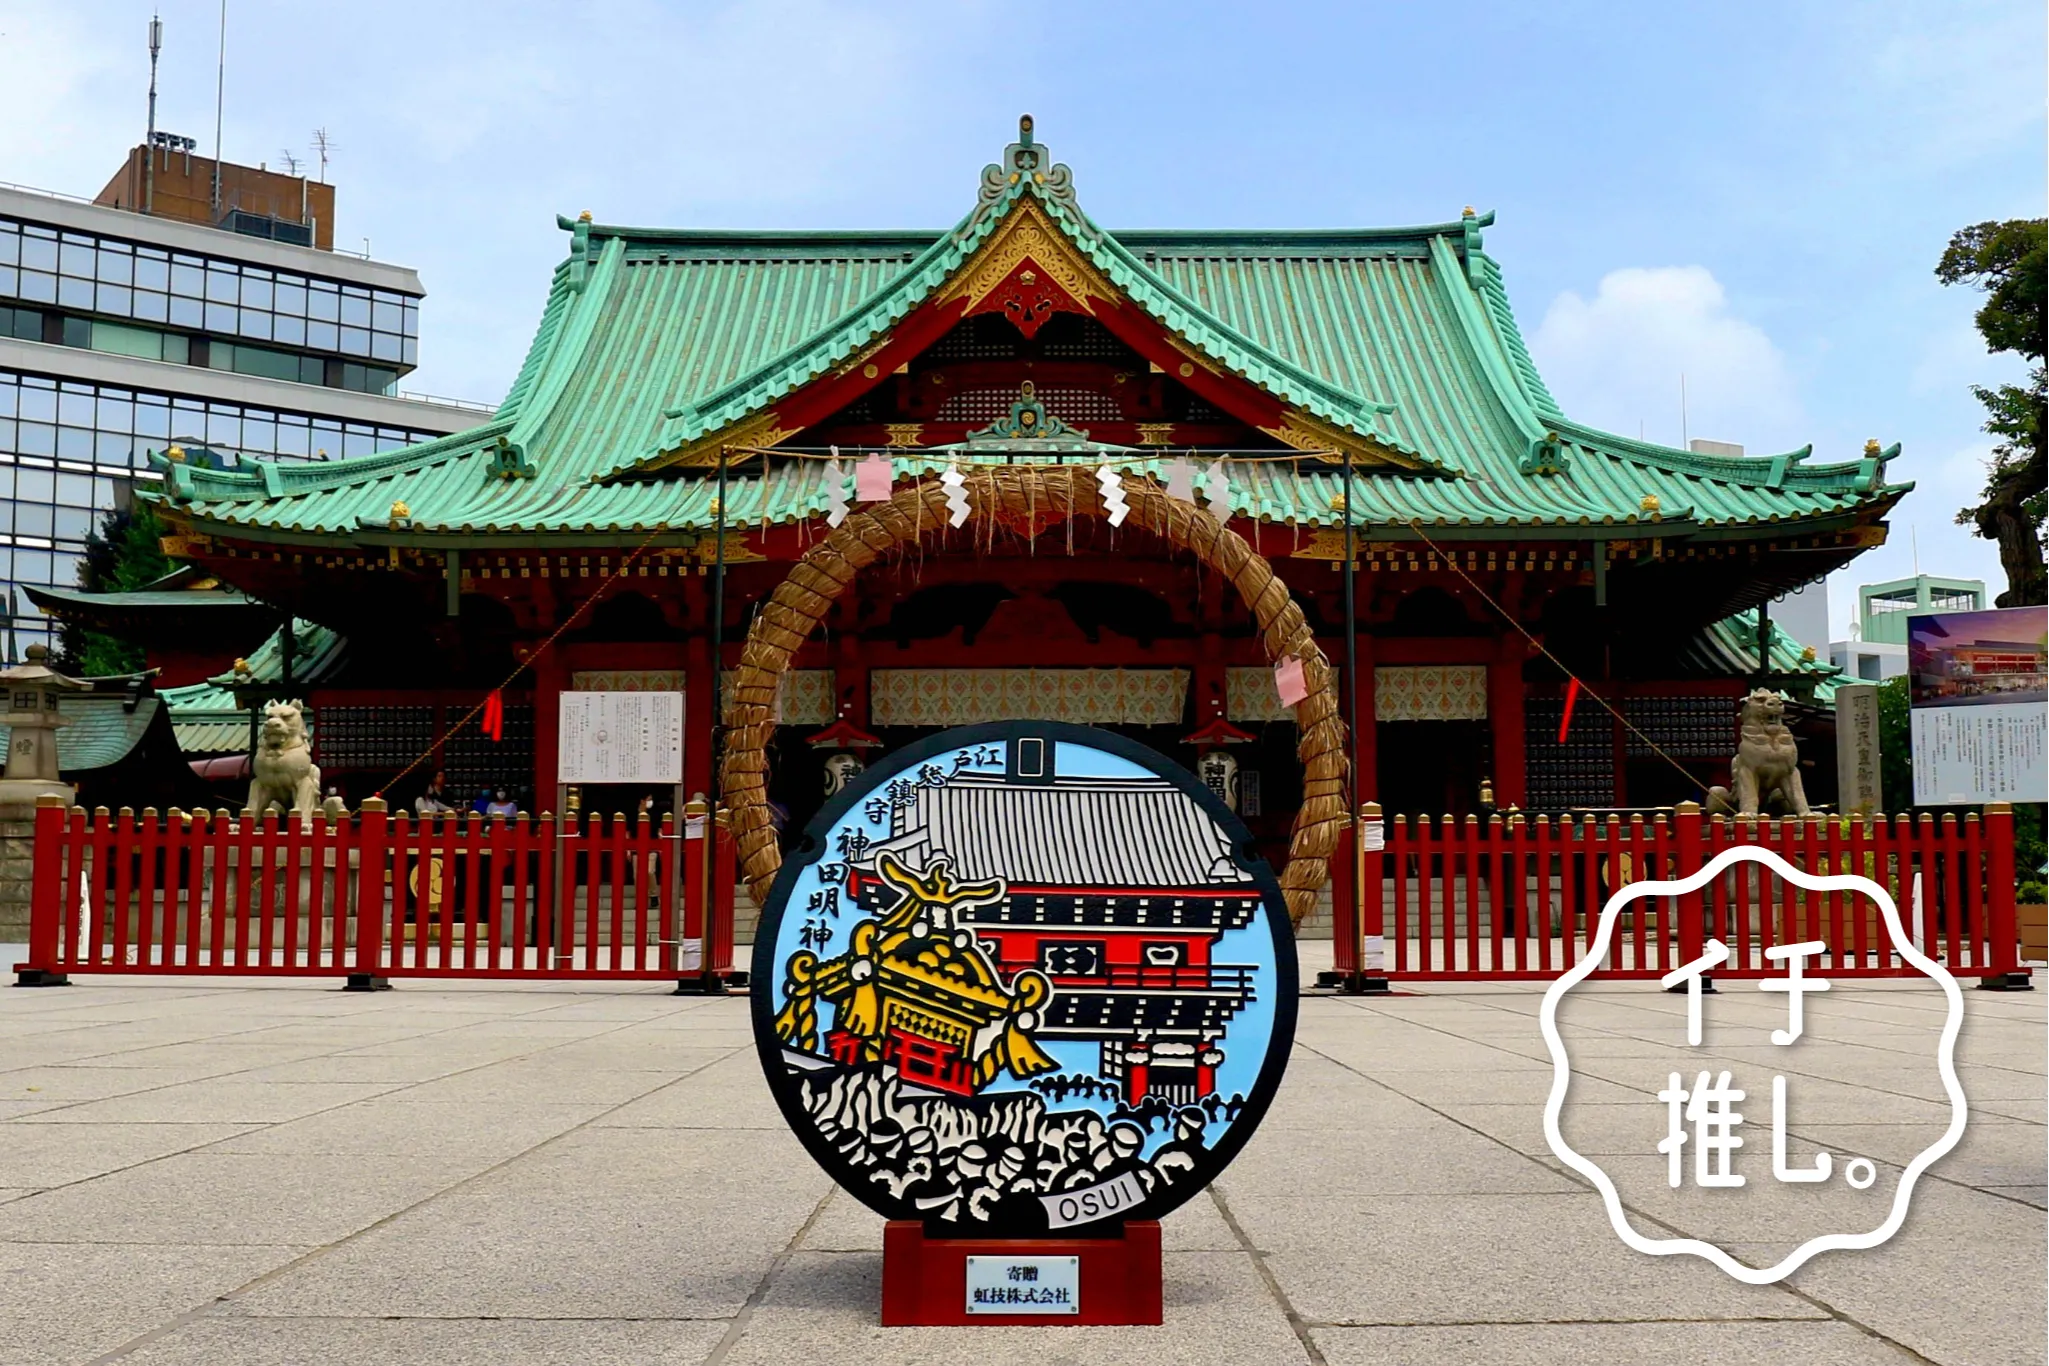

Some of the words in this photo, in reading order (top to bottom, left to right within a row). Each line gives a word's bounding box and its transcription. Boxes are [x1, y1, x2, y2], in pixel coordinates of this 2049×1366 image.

[865, 745, 1004, 825] 江戸総鎮守
[799, 827, 872, 954] 神田明神
[1059, 1180, 1133, 1222] OSUI
[1006, 1265, 1039, 1282] 寄贈
[973, 1287, 1071, 1304] 虹技株式会社
